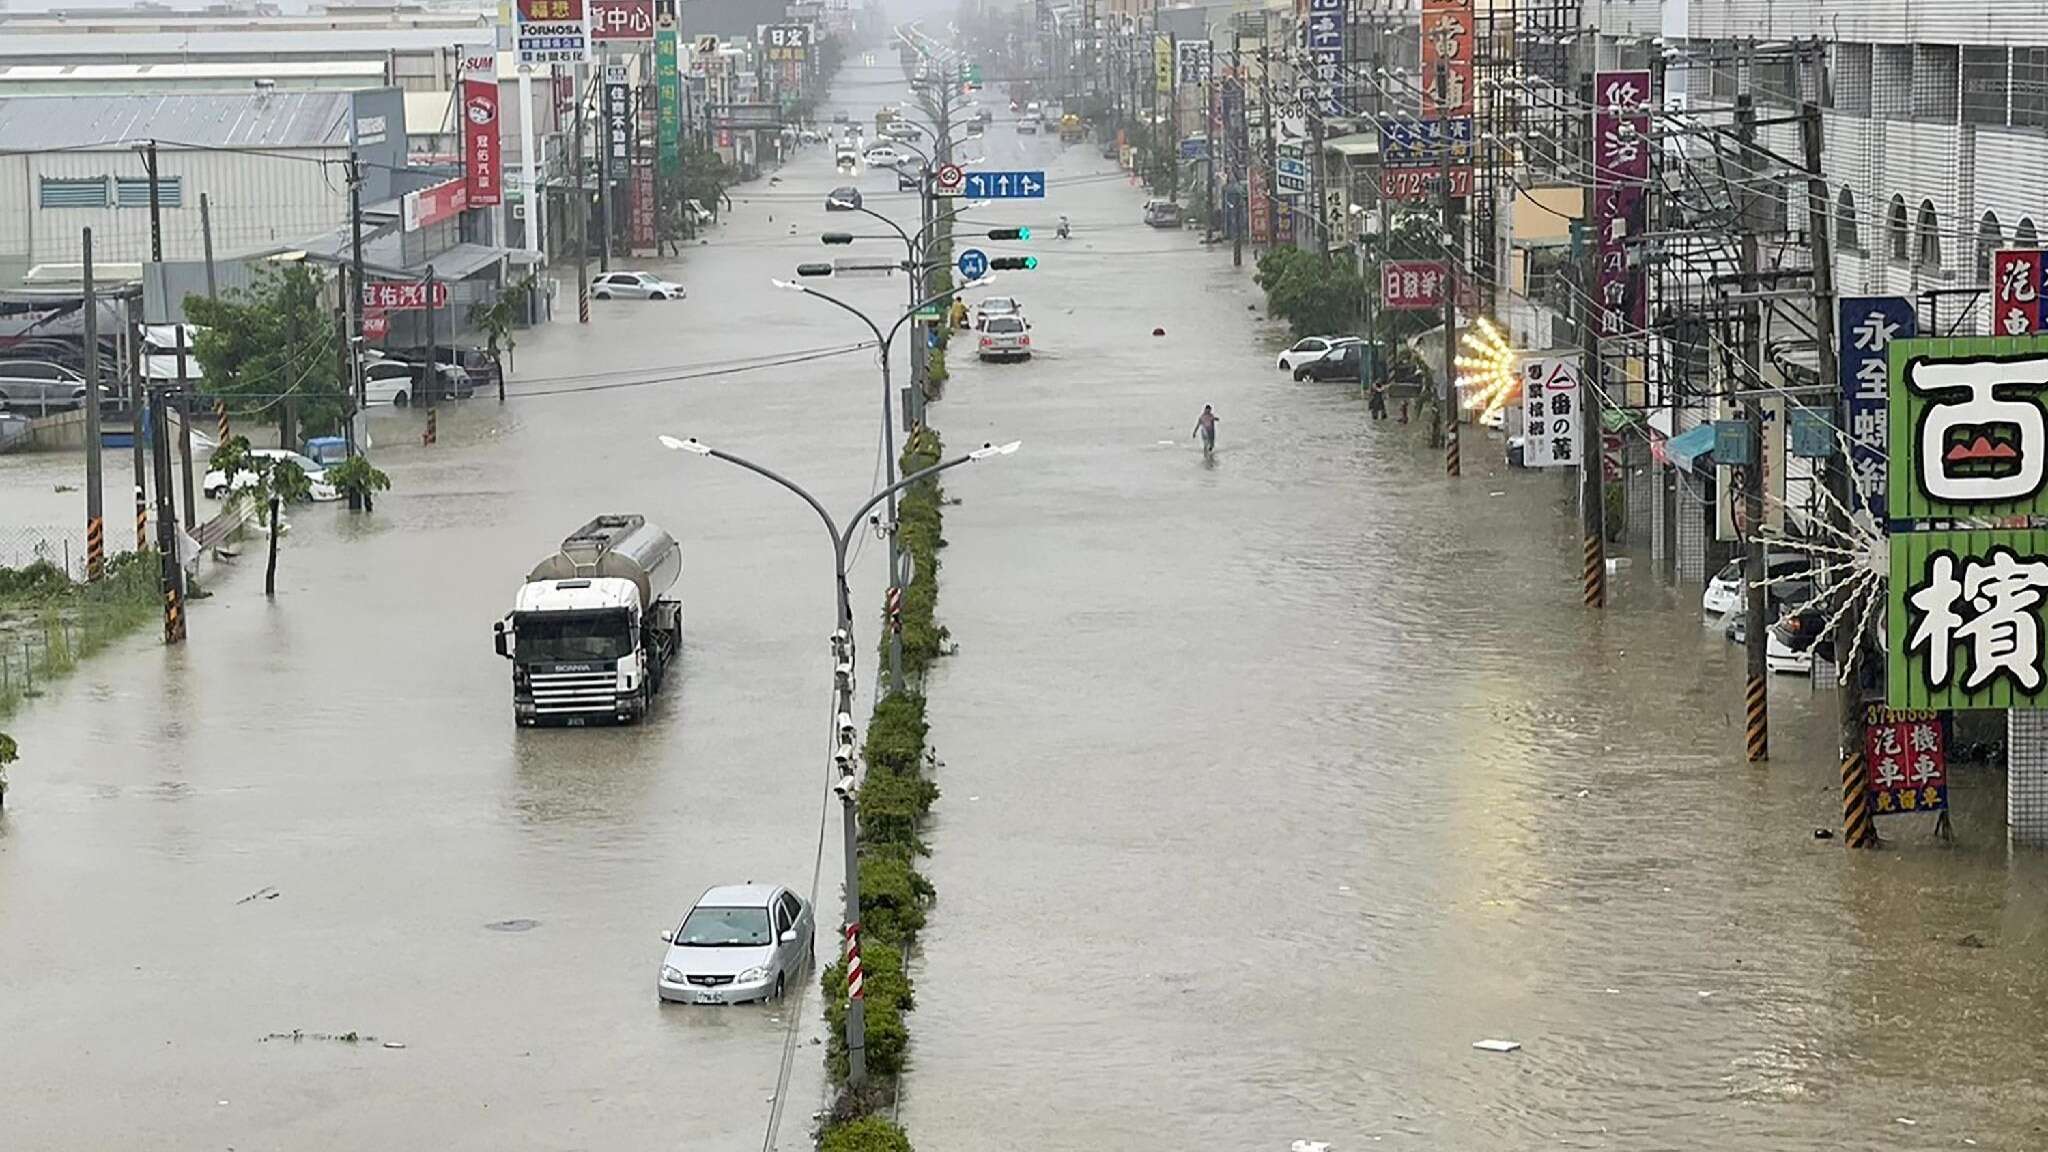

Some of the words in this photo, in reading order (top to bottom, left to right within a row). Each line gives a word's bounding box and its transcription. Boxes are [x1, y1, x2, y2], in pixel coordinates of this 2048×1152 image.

[521, 23, 582, 35] FORMOSA
[466, 57, 493, 69] SUM
[1873, 726, 1906, 788] 汽車
